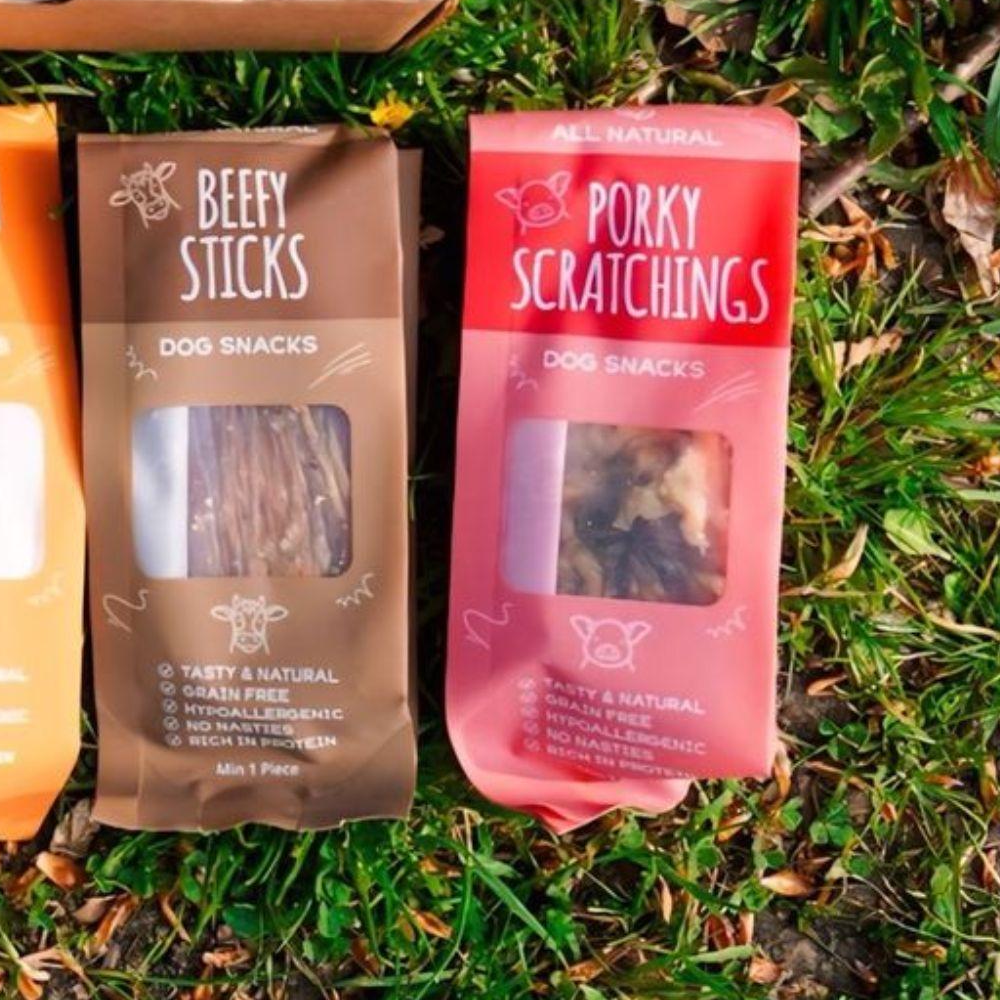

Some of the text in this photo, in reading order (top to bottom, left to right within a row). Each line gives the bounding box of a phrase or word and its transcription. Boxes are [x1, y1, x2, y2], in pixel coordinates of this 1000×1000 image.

[551, 124, 723, 147] ALL NATURAL
[198, 167, 288, 231] BEEFY
[587, 181, 700, 250] PORKY
[179, 233, 310, 302] STICKS
[510, 247, 770, 325] SCRATCHINGS
[159, 334, 318, 357] DOG SNACKS
[543, 350, 706, 379] DOG SNACKS
[181, 665, 340, 684] TASTY & NATURAL
[182, 685, 290, 703] GRAIN FREE
[543, 677, 706, 715] TASTY & NATURAL
[184, 703, 344, 721] HYPOALLERGENIC
[543, 694, 651, 728] GRAIN FREE
[186, 720, 295, 736] NO NASTIES
[545, 710, 706, 755] HYPOALLERGENIC
[188, 735, 338, 750] RICH IN PROTEIN
[546, 727, 655, 761] NO NASTIES
[546, 745, 591, 763] RICH
[215, 763, 300, 777] Min 1 Piece
